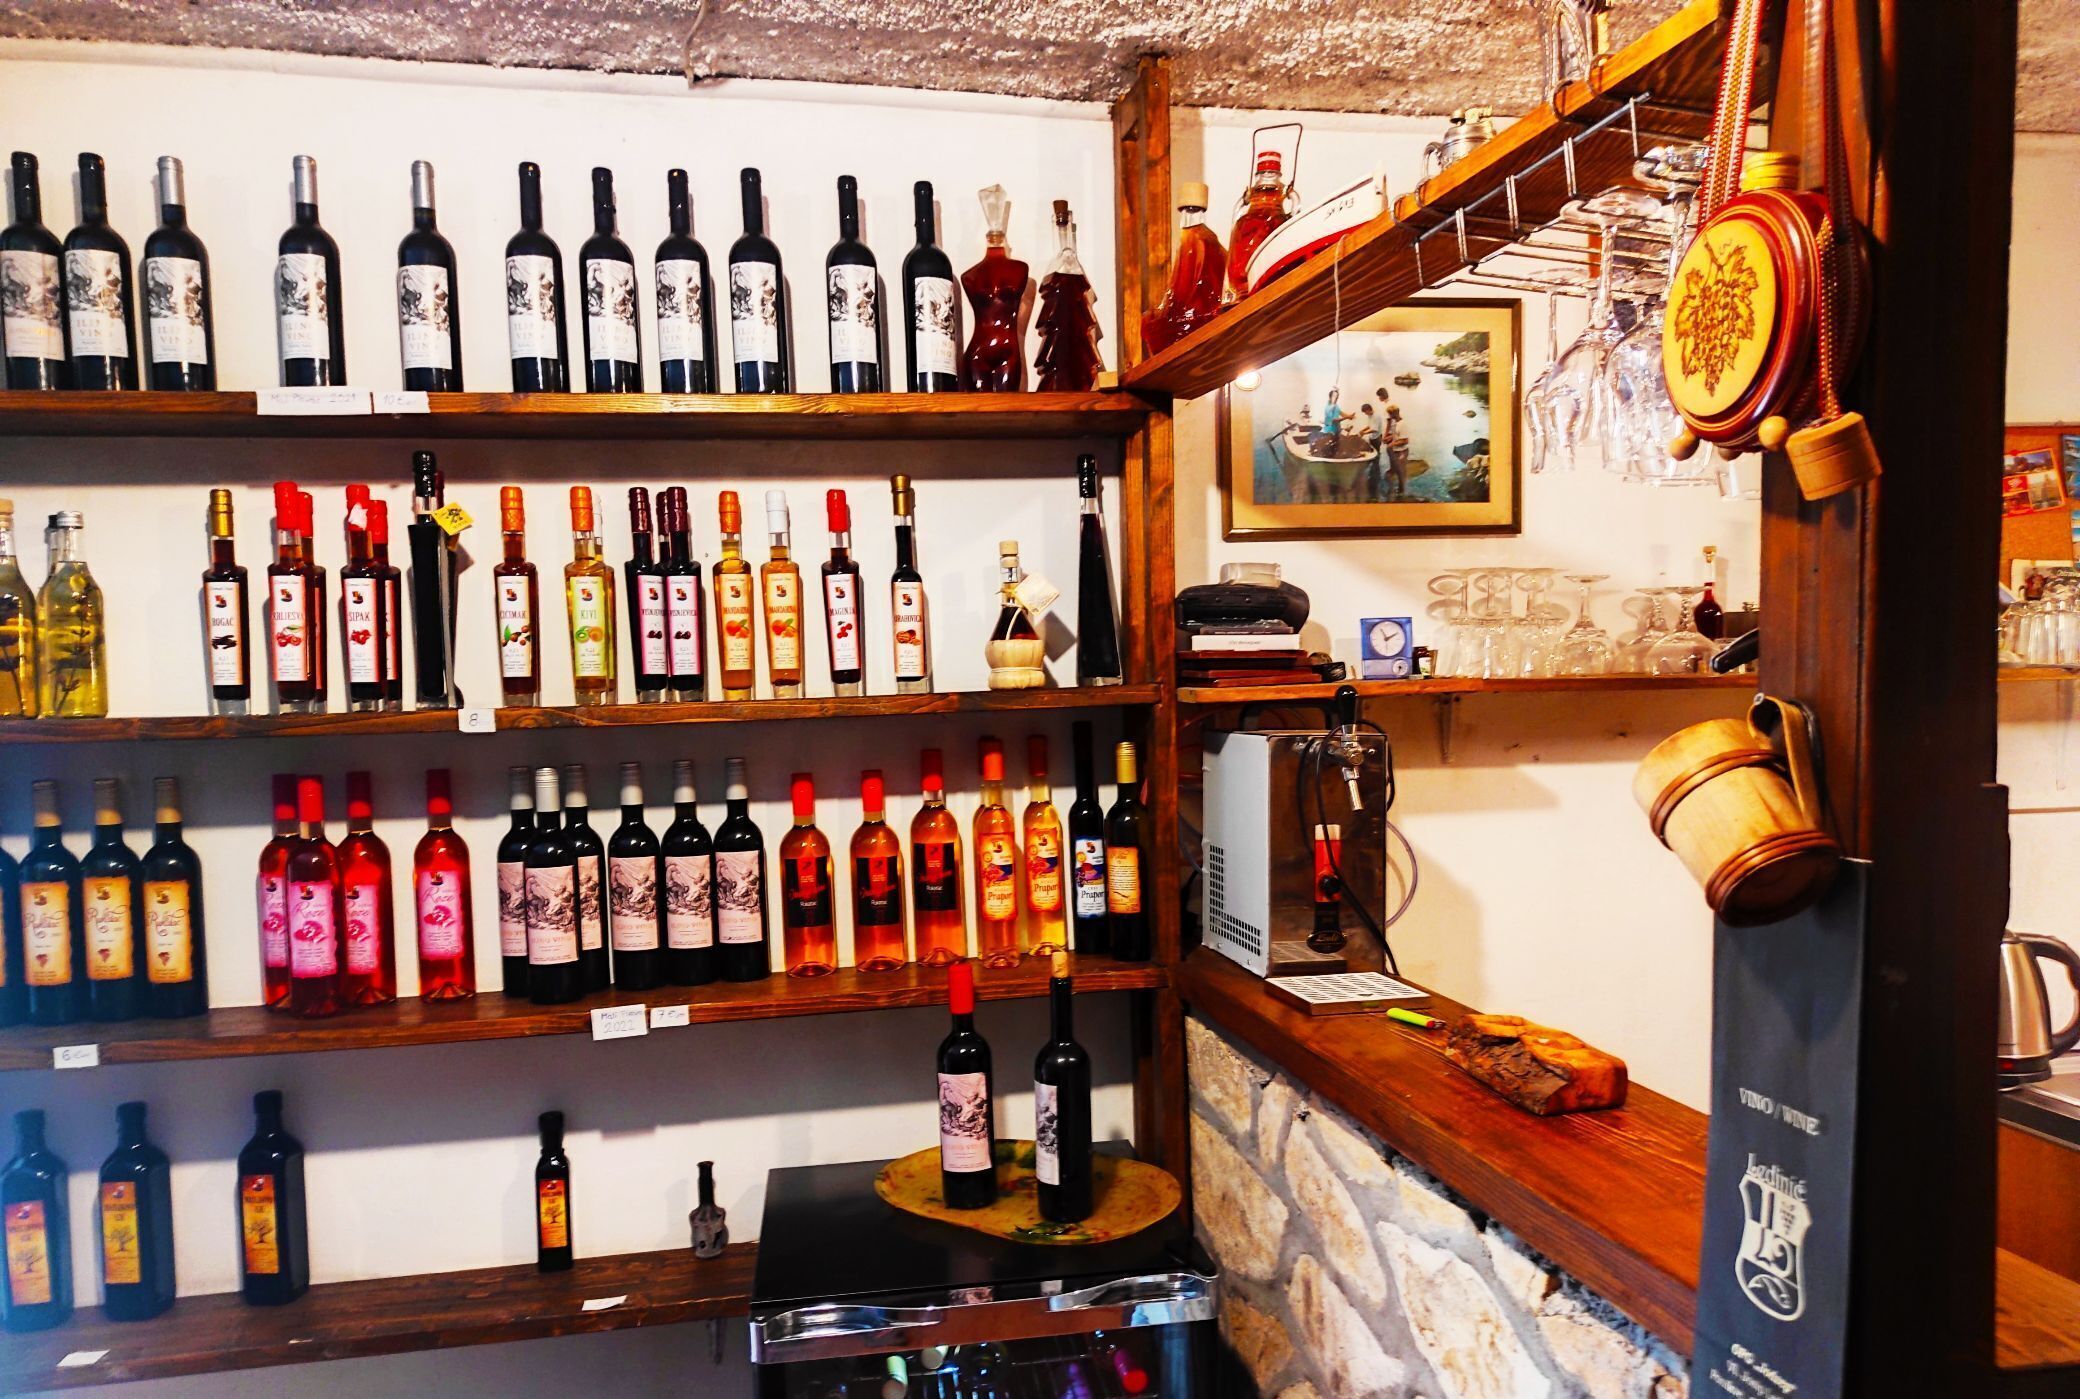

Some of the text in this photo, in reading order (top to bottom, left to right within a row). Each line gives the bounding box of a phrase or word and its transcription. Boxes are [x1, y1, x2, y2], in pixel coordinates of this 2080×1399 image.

[580, 610, 597, 620] KIVI
[469, 713, 479, 726] 8
[1033, 883, 1058, 895] Prapor
[988, 891, 1013, 904] Prapor
[1081, 890, 1104, 902] Prapor
[1739, 1087, 1774, 1114] VINO
[1782, 1105, 1822, 1136] WINE
